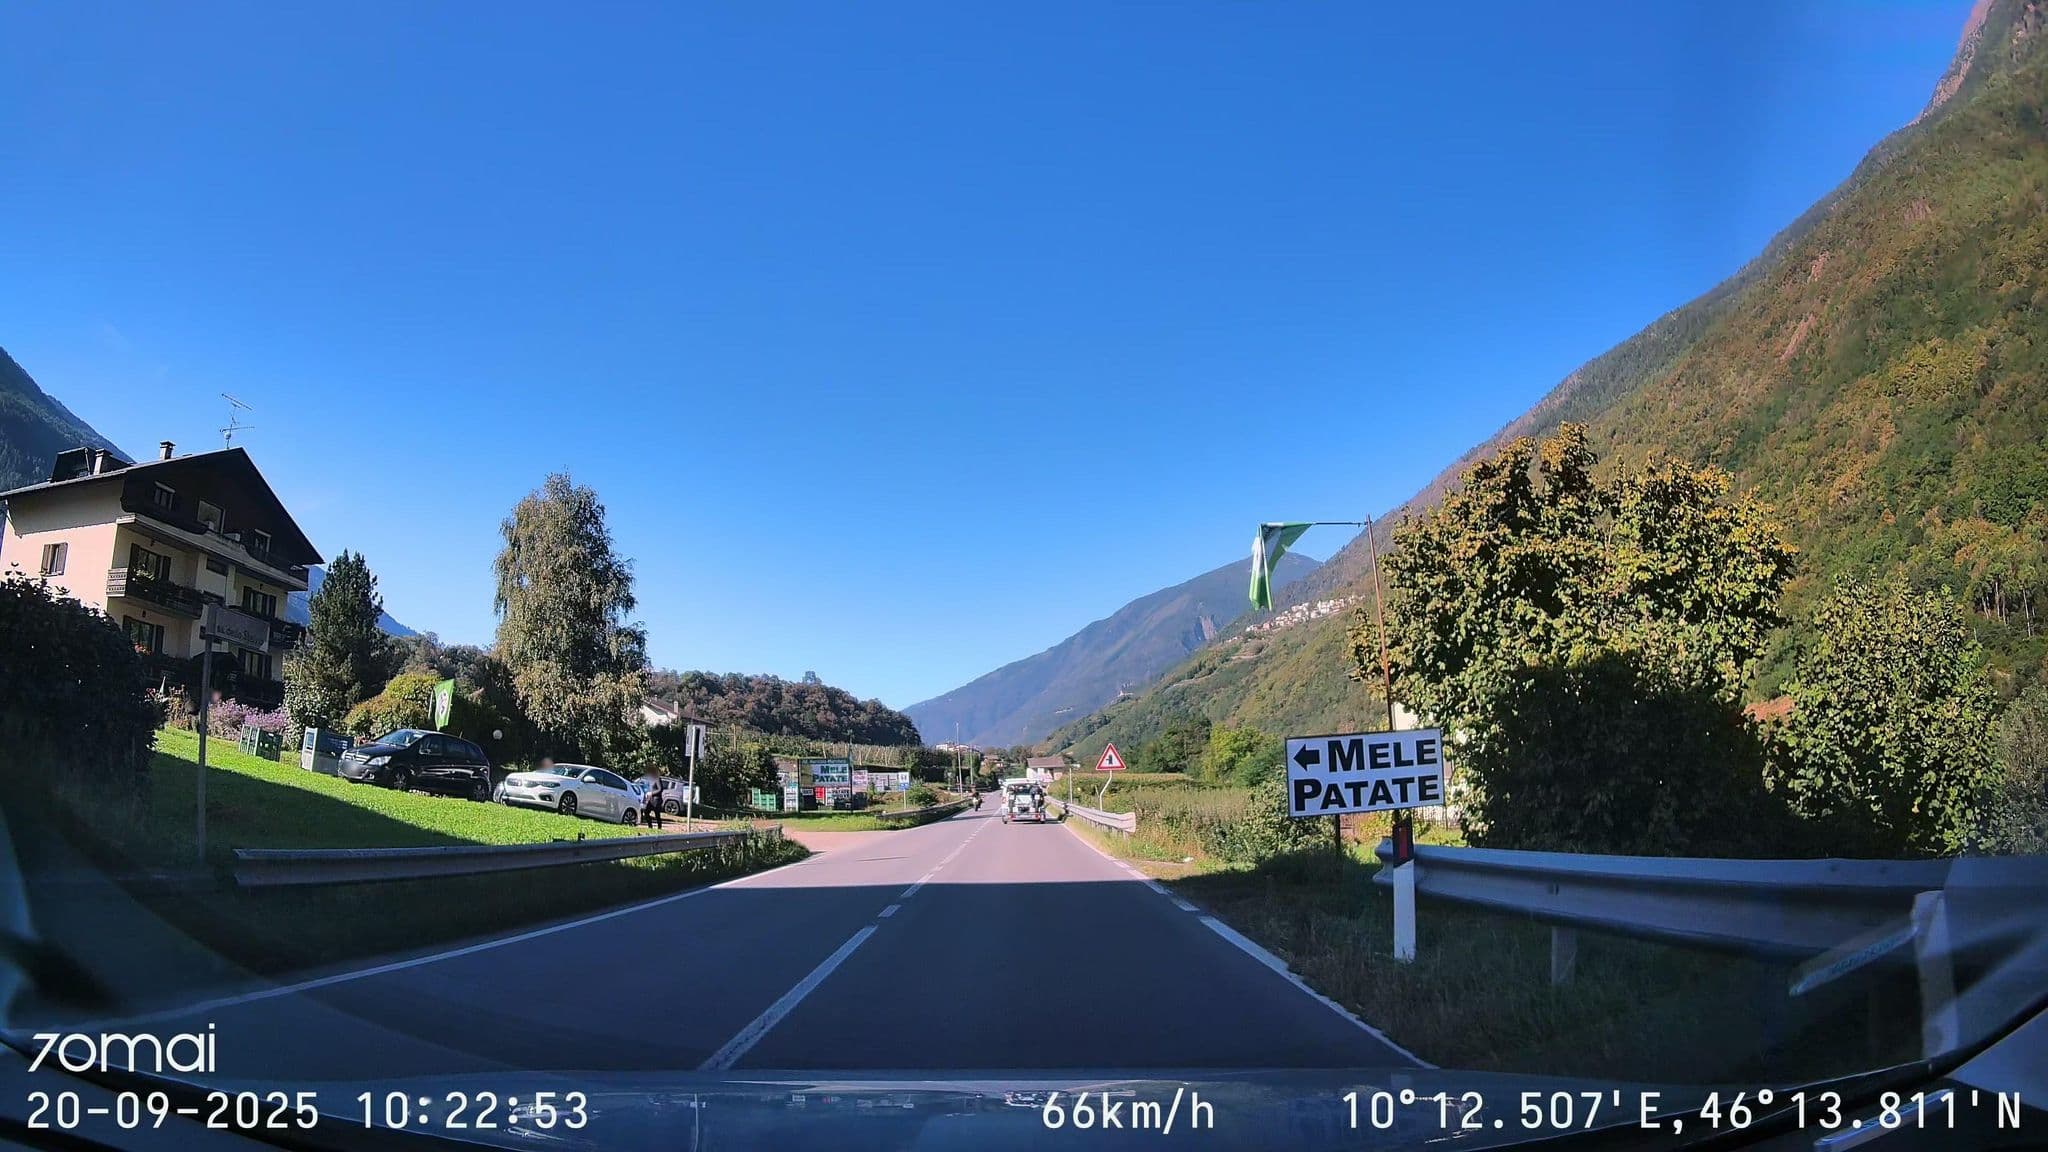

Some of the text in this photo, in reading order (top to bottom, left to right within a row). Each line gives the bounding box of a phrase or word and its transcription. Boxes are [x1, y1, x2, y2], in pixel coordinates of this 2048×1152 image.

[1328, 739, 1438, 772] MELE
[812, 773, 848, 783] PATATE
[820, 765, 848, 774] MELE
[1294, 775, 1440, 811] PATATE
